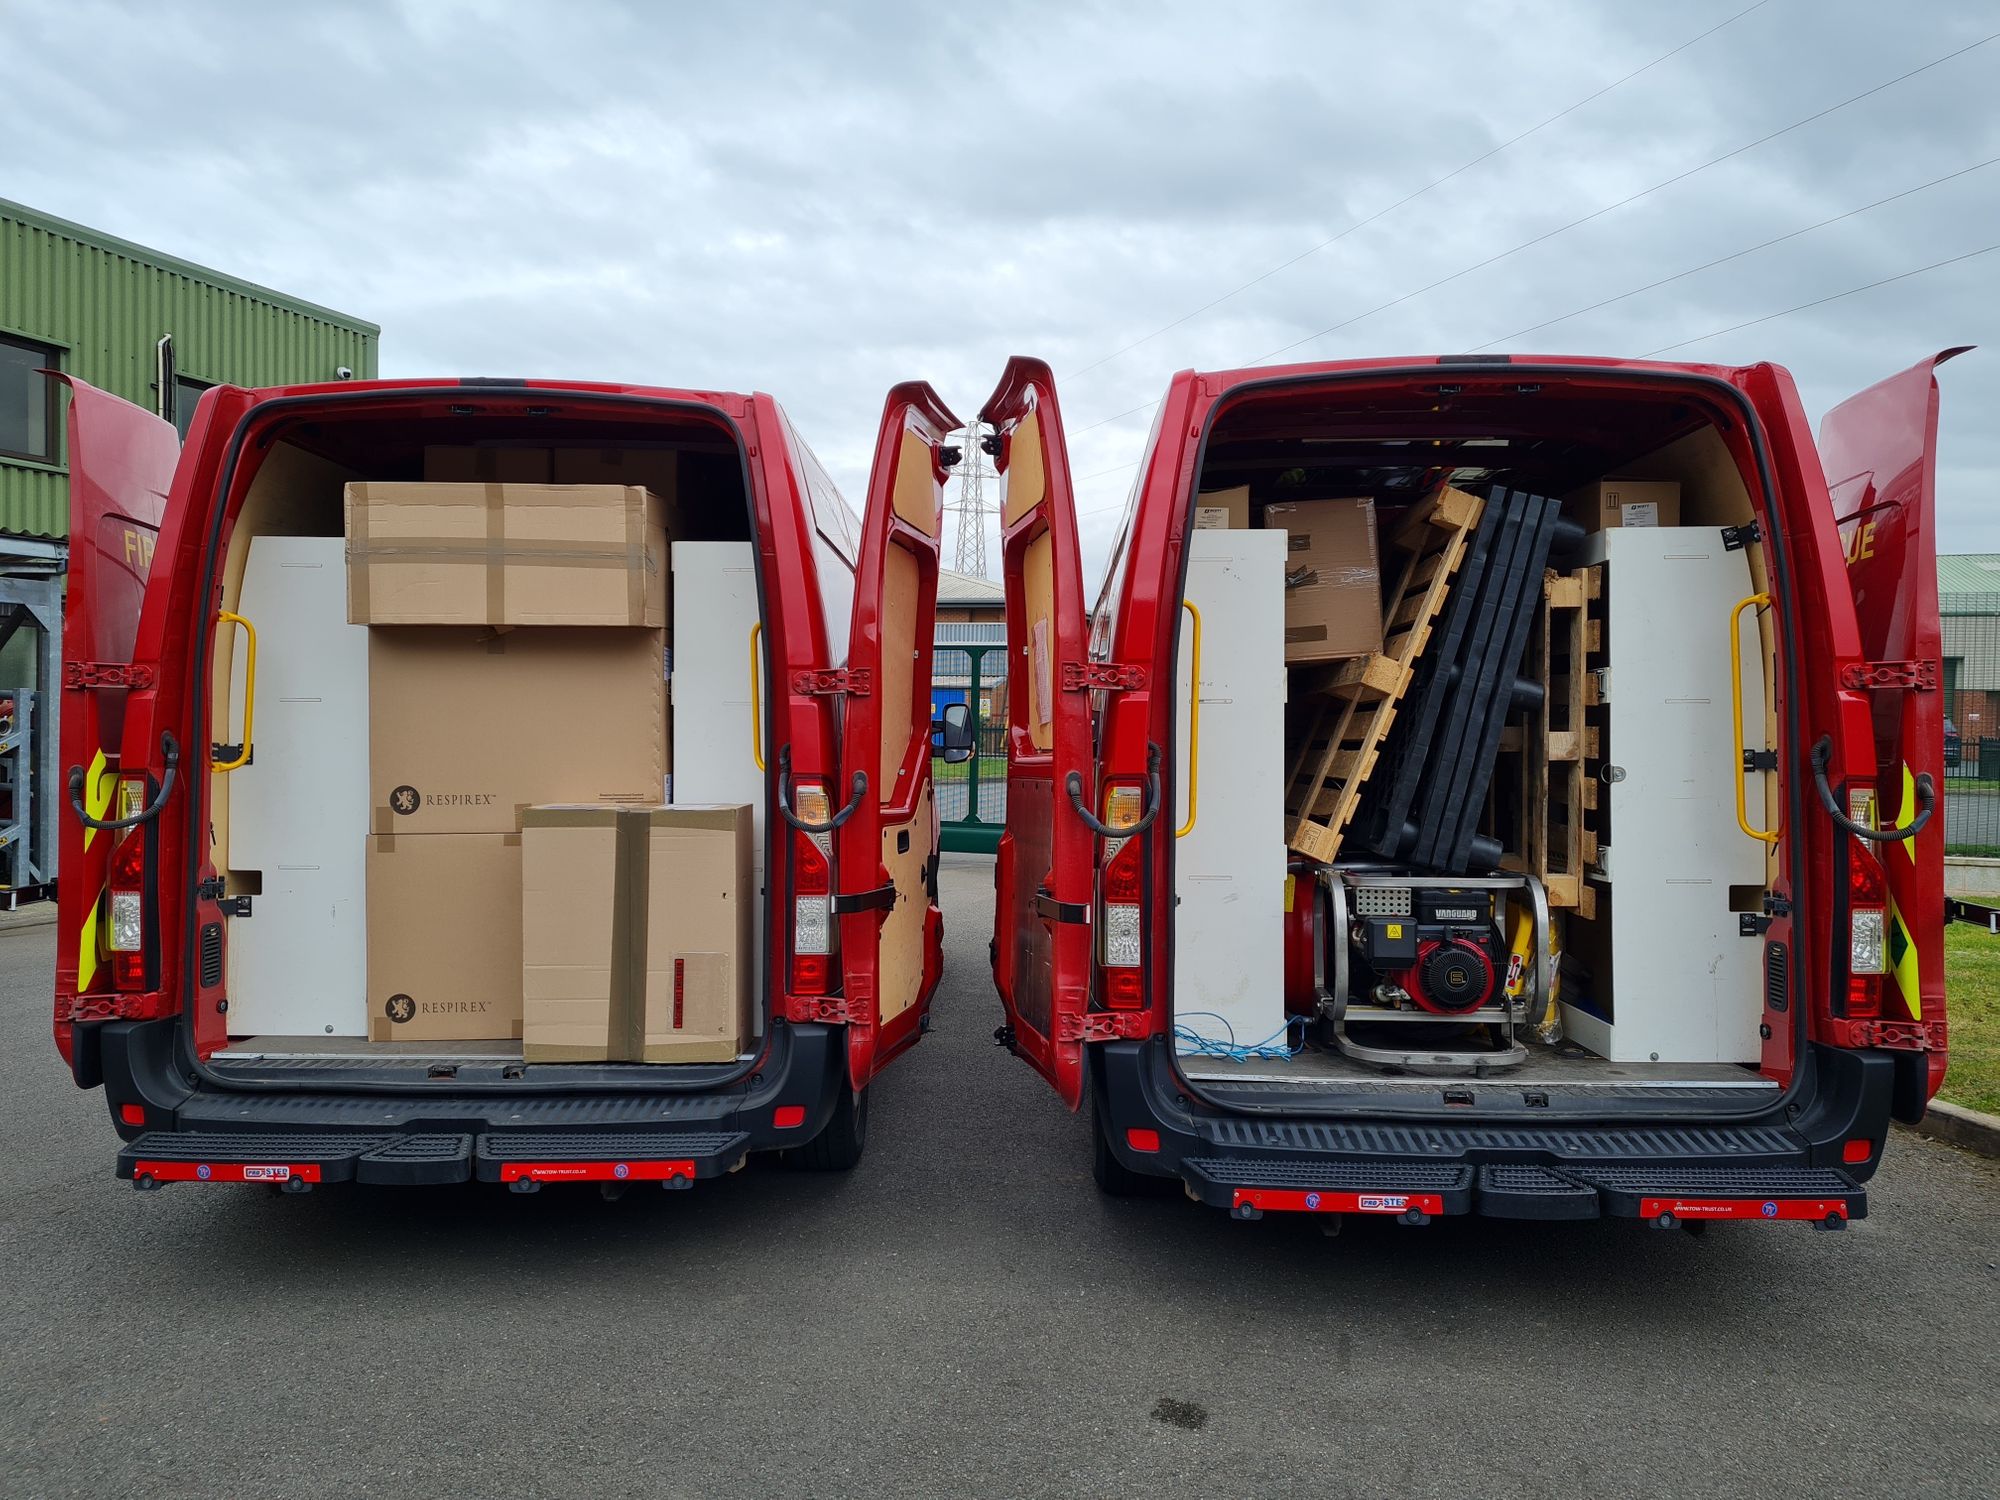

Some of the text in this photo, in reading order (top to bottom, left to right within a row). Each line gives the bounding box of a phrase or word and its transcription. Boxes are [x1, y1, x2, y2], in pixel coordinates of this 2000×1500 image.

[124, 529, 155, 568] FIR
[426, 794, 491, 806] RESPIREX
[1435, 908, 1478, 921] VANGUARD
[422, 1001, 487, 1014] RESPIREX
